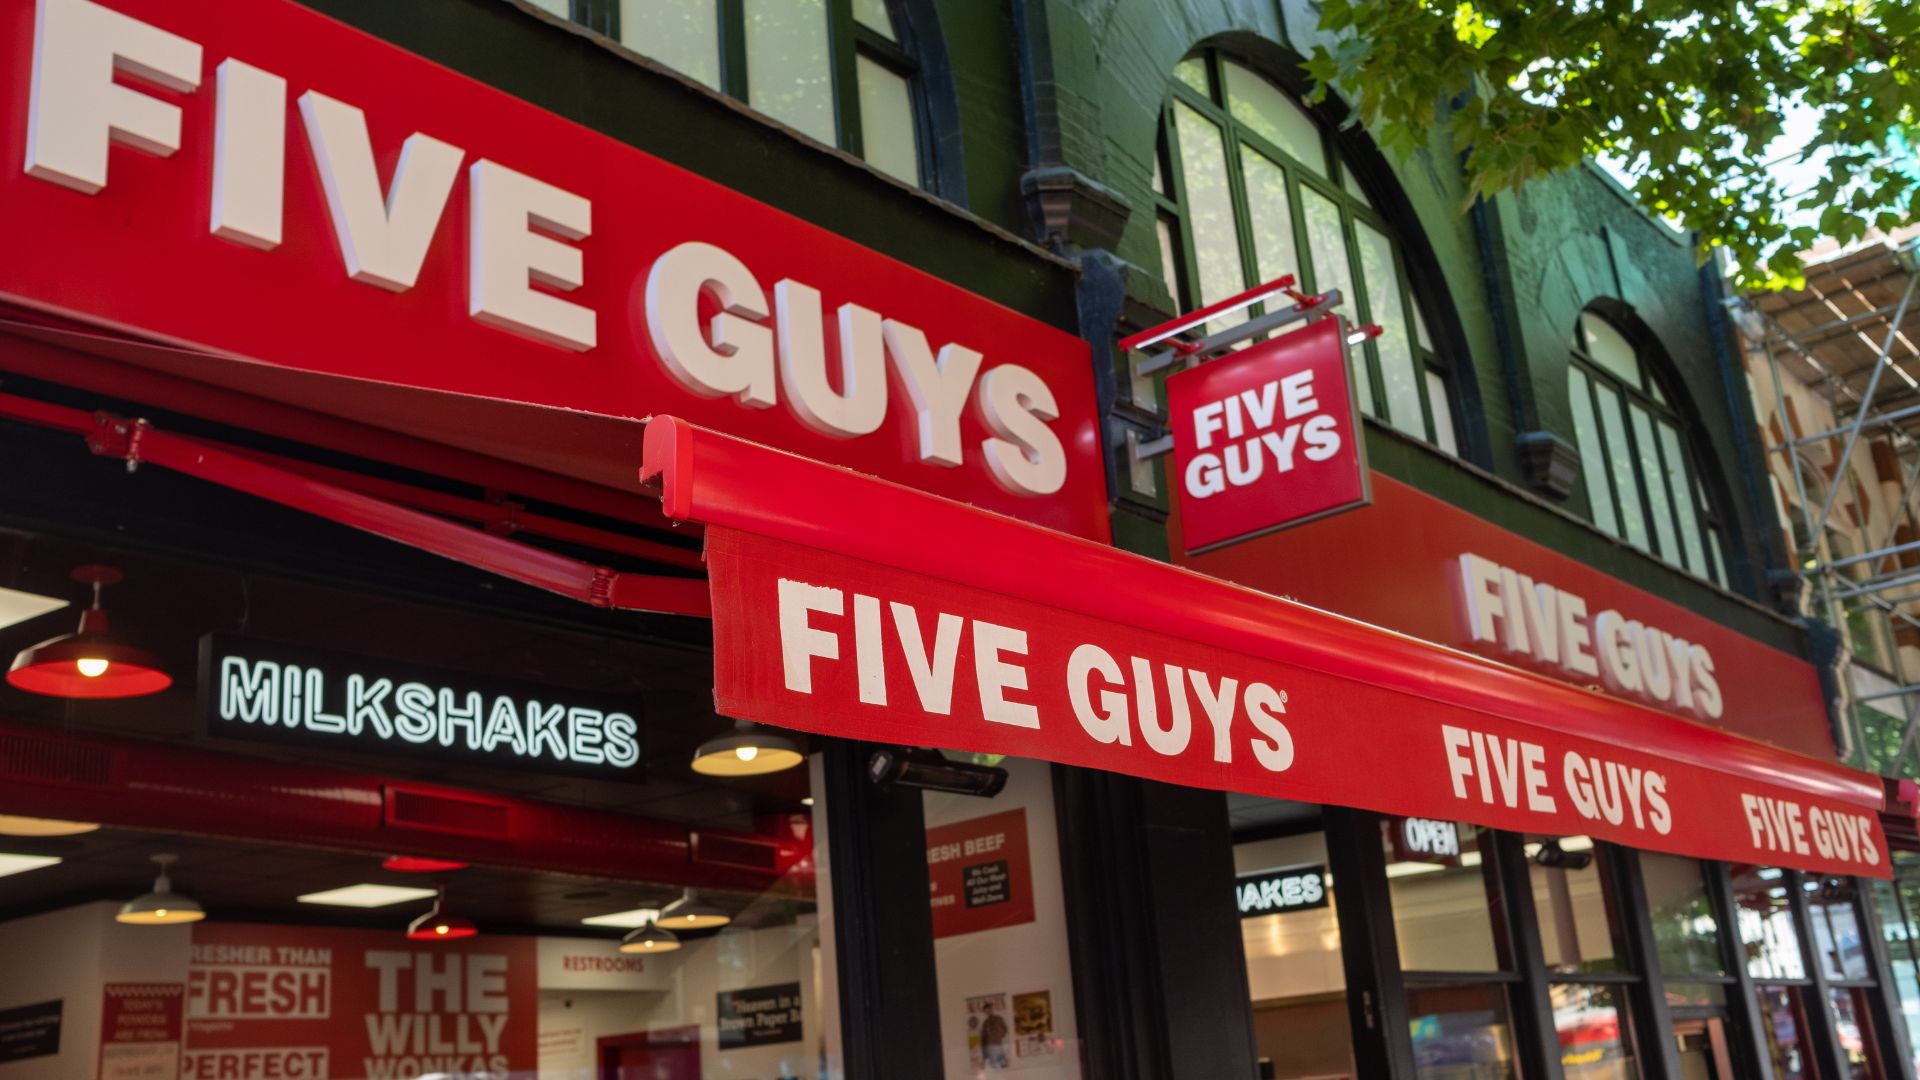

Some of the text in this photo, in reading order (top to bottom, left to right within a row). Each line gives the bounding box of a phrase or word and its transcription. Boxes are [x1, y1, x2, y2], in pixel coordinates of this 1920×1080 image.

[25, 0, 1067, 495] FIVE GUYS
[1193, 369, 1319, 450] FIVE
[1185, 414, 1341, 499] GUYS
[778, 577, 1041, 730] FIVE
[1459, 552, 1723, 719] FIVE GUYS
[219, 655, 639, 769] MILKSHAKES
[1441, 724, 1557, 814] FIVE
[963, 832, 1005, 857] BEEF
[1404, 816, 1459, 856] OPEN
[1740, 793, 1810, 856] FIVE
[277, 946, 332, 966] THAN
[365, 951, 509, 1013] THE
[562, 955, 645, 972] RESTROOMS
[364, 1013, 507, 1055] WILLY
